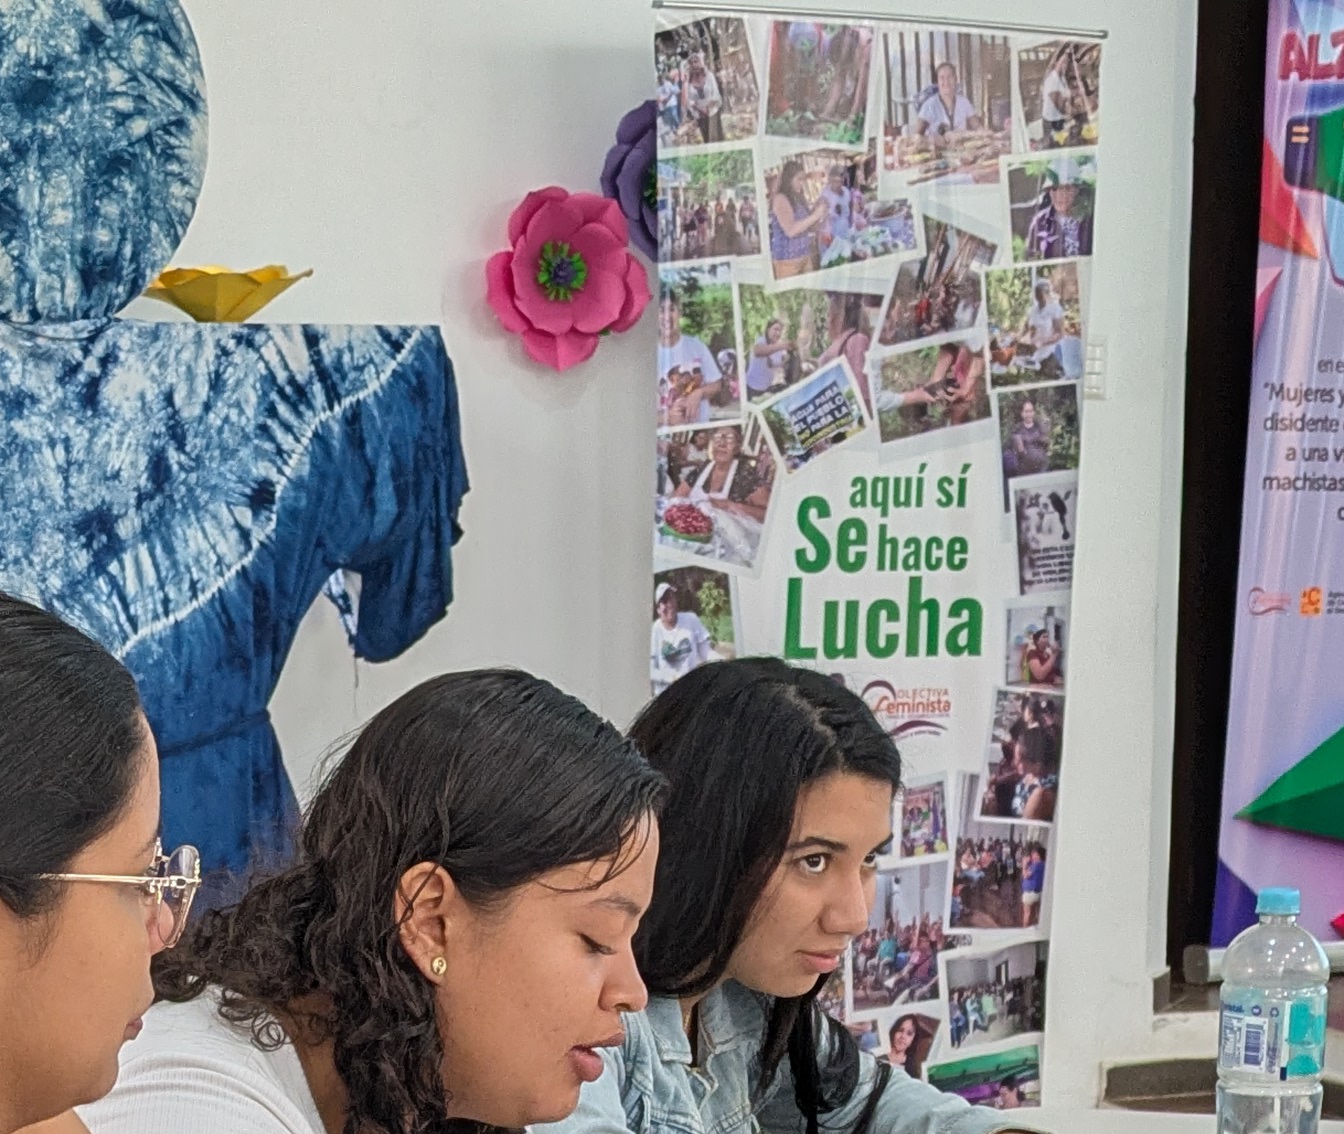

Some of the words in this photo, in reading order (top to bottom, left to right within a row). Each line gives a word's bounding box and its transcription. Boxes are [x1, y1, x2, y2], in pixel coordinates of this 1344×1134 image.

[1318, 360, 1333, 373] en
[1263, 412, 1339, 432] disidente
[1285, 447, 1296, 461] a
[1302, 447, 1329, 461] una
[849, 464, 928, 517] aquí
[936, 464, 972, 508] sí
[794, 495, 869, 574] Se
[876, 524, 969, 571] hace
[784, 576, 984, 659] Lucha
